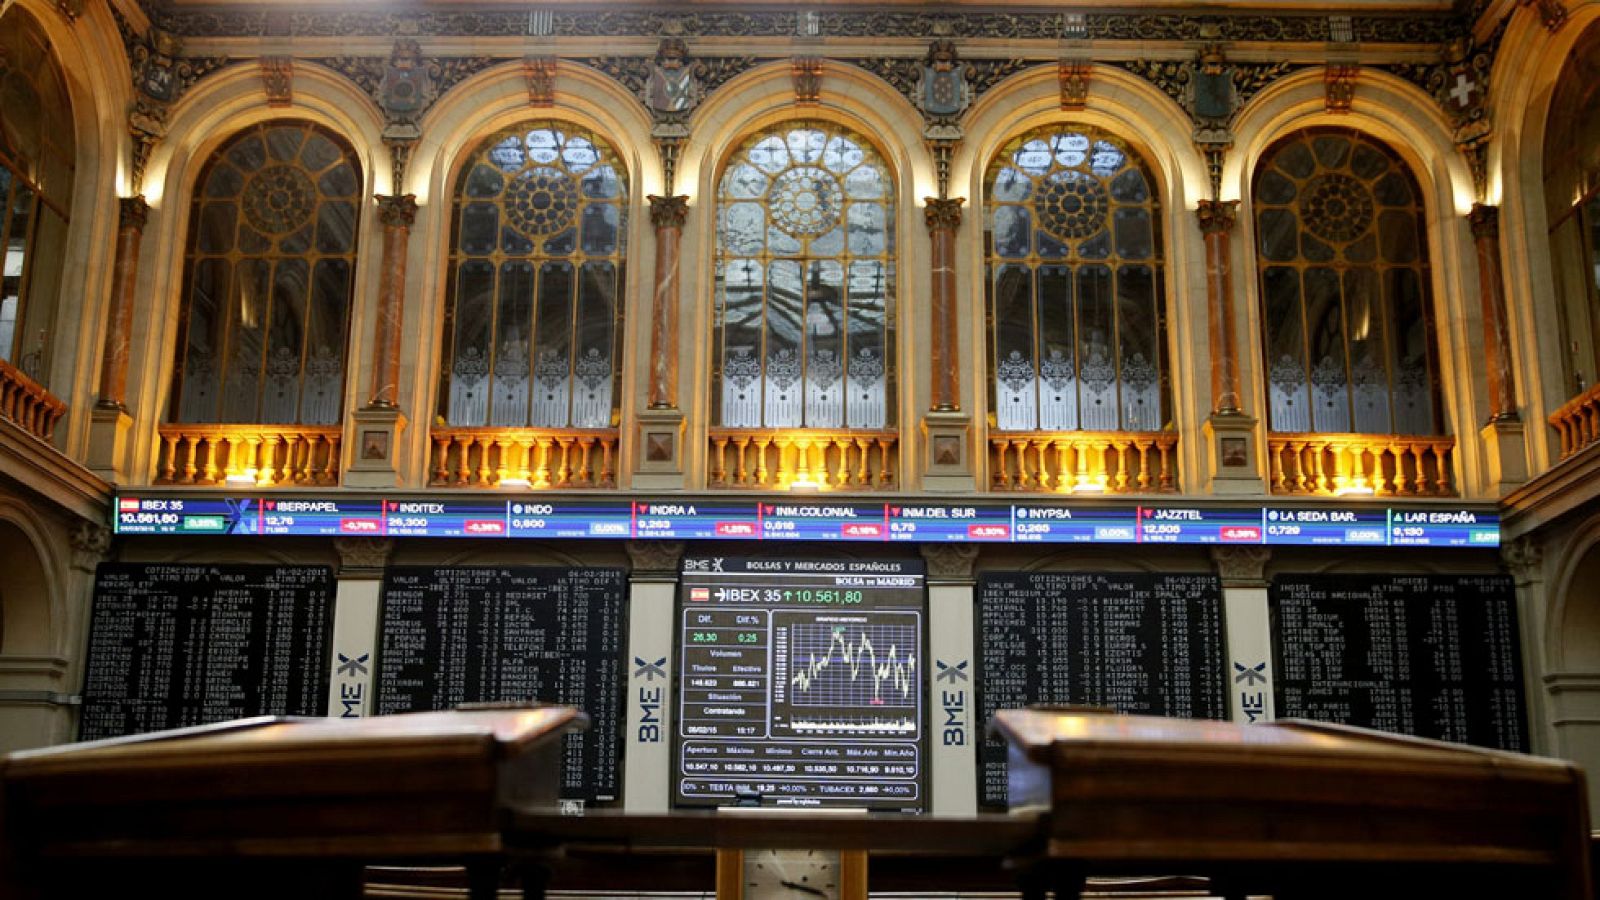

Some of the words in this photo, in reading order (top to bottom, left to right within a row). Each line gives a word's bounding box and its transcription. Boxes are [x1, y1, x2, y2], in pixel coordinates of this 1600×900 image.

[141, 500, 168, 510] IBEX
[170, 500, 183, 510] 35
[277, 502, 339, 512] IBERPAPEL
[400, 503, 445, 513] INDITEX
[524, 504, 552, 514] INDO
[650, 505, 686, 515] INDRA
[687, 506, 696, 515] A
[776, 507, 857, 517] INM.COLONIAL
[902, 508, 948, 518] INM.DEL
[952, 508, 976, 518] SUR
[1029, 509, 1071, 519] INYPSA
[1155, 510, 1202, 520] JAZZTEL
[1280, 511, 1295, 521] LA
[1297, 512, 1328, 522] SEDA
[1330, 512, 1357, 522] BAR.
[1405, 513, 1427, 523] LAR
[1430, 511, 1476, 523] ESPAÑA
[684, 559, 709, 570] BME
[745, 561, 782, 570] BOLSAS
[784, 561, 791, 570] Y
[794, 562, 845, 571] MERCADOS
[849, 562, 902, 572] ESPAÑOLES
[836, 577, 864, 586] BOLSA
[876, 578, 914, 586] MADRID
[726, 589, 760, 602] IBEX
[764, 590, 782, 602] 35
[795, 591, 862, 605] 10.561,80
[341, 683, 361, 717] ME
[638, 687, 660, 742] BME
[943, 691, 964, 746] BME
